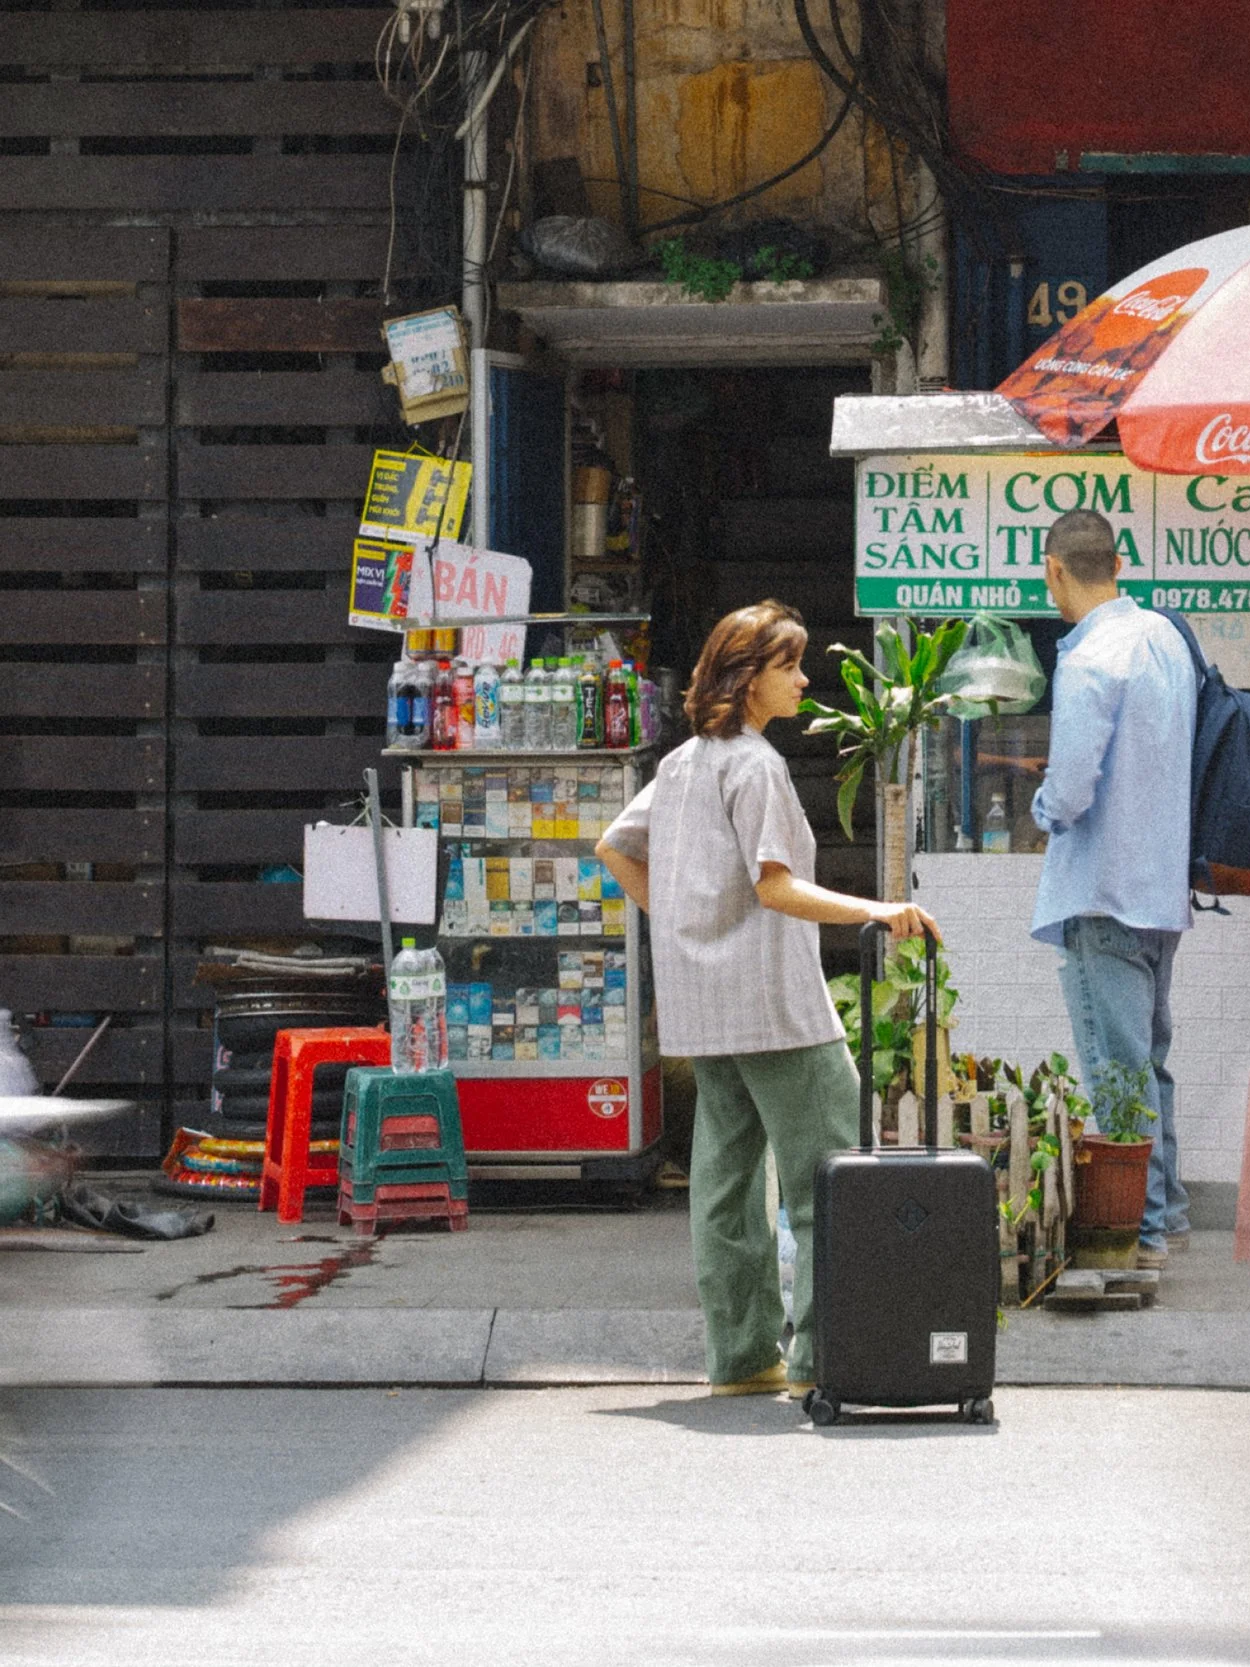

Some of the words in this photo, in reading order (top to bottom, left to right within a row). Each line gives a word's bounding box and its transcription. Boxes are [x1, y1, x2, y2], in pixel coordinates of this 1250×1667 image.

[865, 463, 971, 499] ĐIỂM
[1004, 470, 1135, 514] CƠM
[873, 502, 965, 534] TÂM
[864, 537, 981, 570] SÁNG
[434, 555, 508, 617] BÁN
[896, 581, 963, 608] QUÁN
[970, 579, 1022, 608] NHỎ
